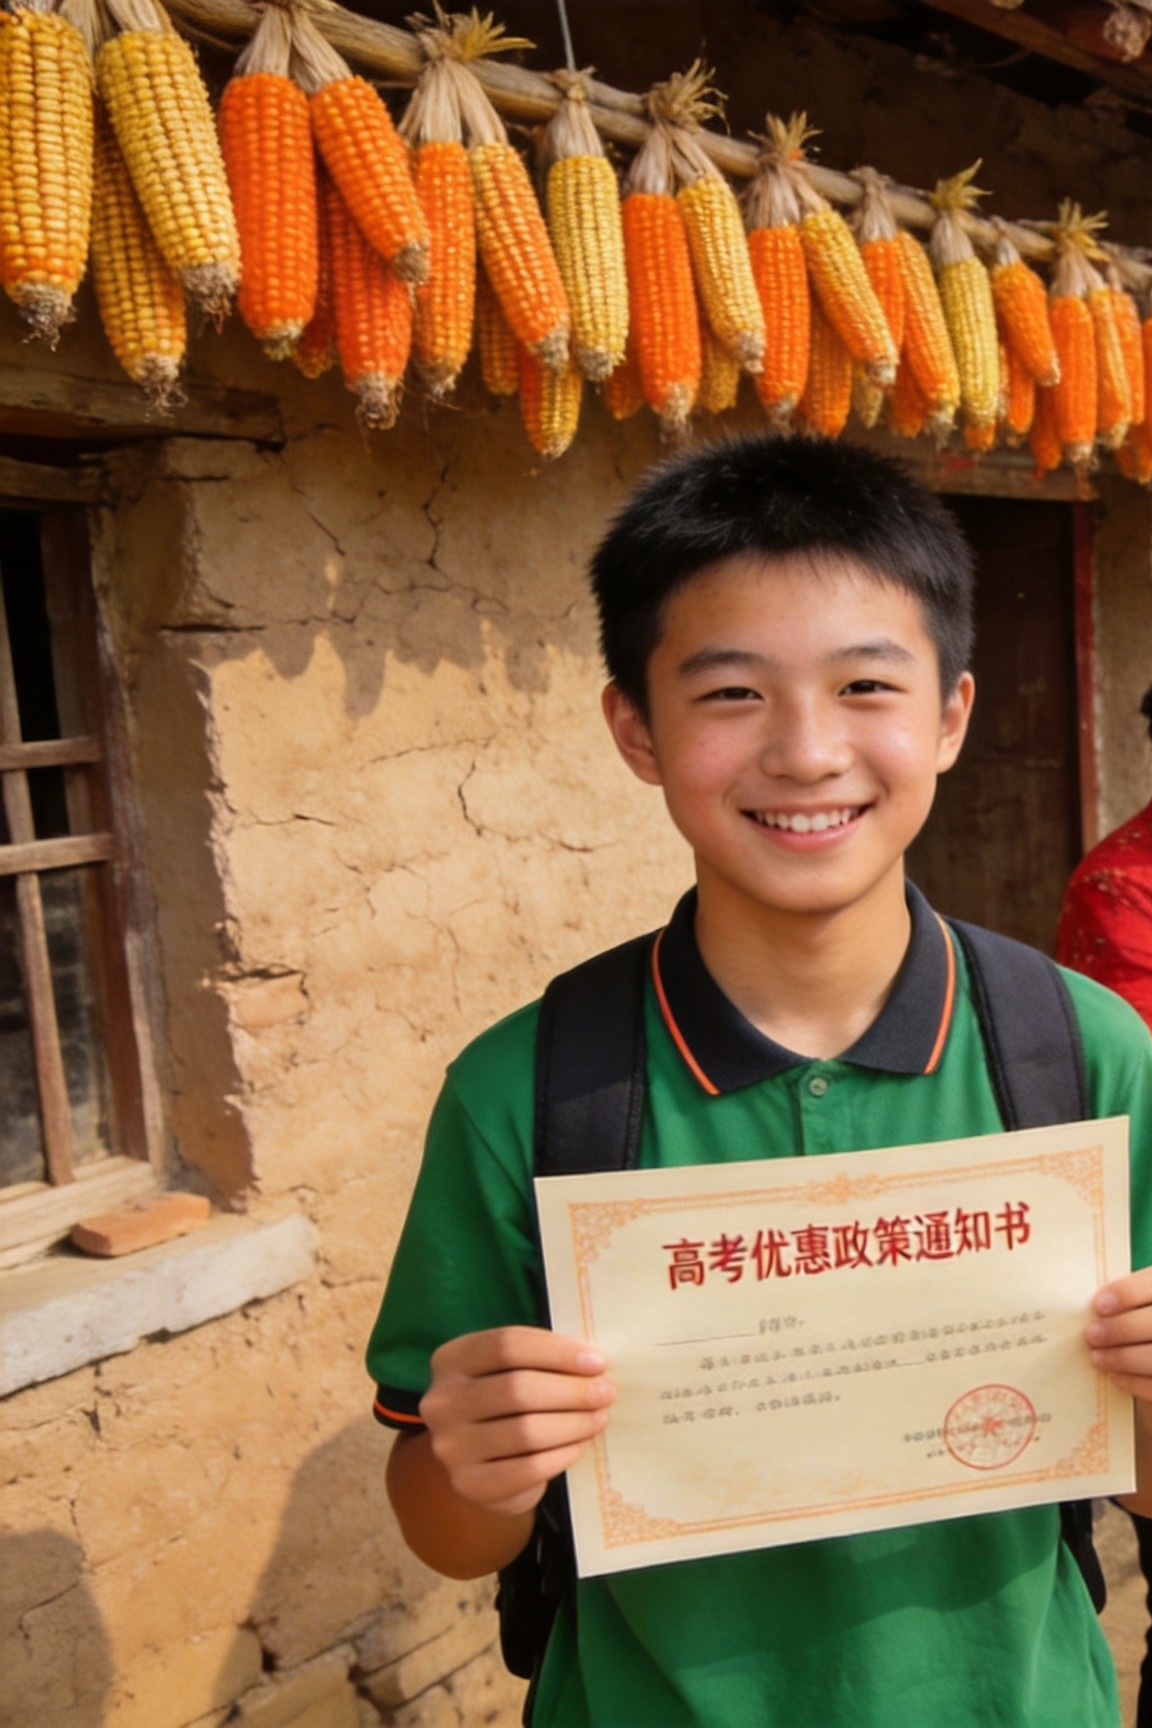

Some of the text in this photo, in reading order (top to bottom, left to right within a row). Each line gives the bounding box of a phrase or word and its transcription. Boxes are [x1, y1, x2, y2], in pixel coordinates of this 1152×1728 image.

[661, 1201, 1031, 1291] 高考优惠政策通知书
